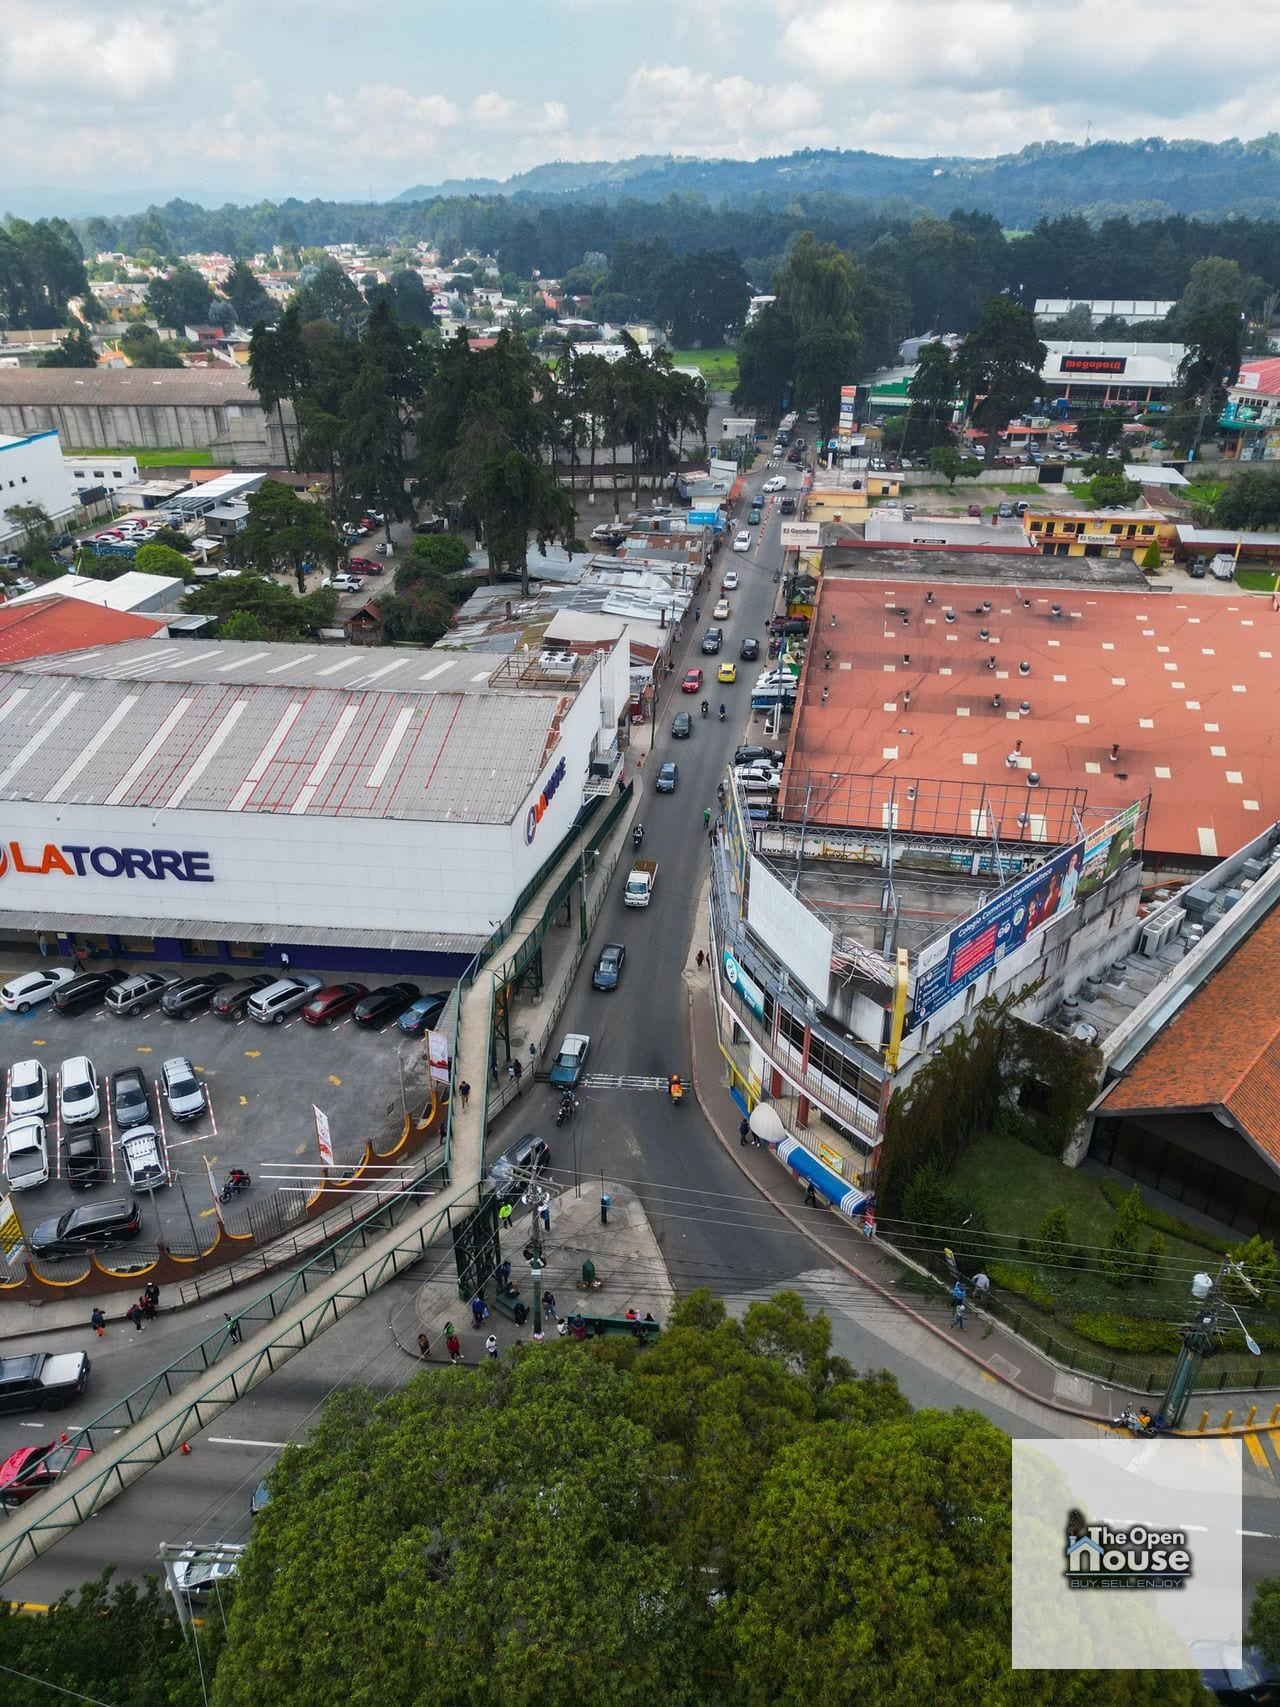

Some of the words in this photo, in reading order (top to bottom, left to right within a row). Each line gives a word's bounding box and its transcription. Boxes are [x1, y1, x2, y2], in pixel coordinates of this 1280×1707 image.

[958, 915, 982, 938] Colegio
[982, 892, 1012, 920] Comercial
[1012, 867, 1053, 898] Guatemalteco
